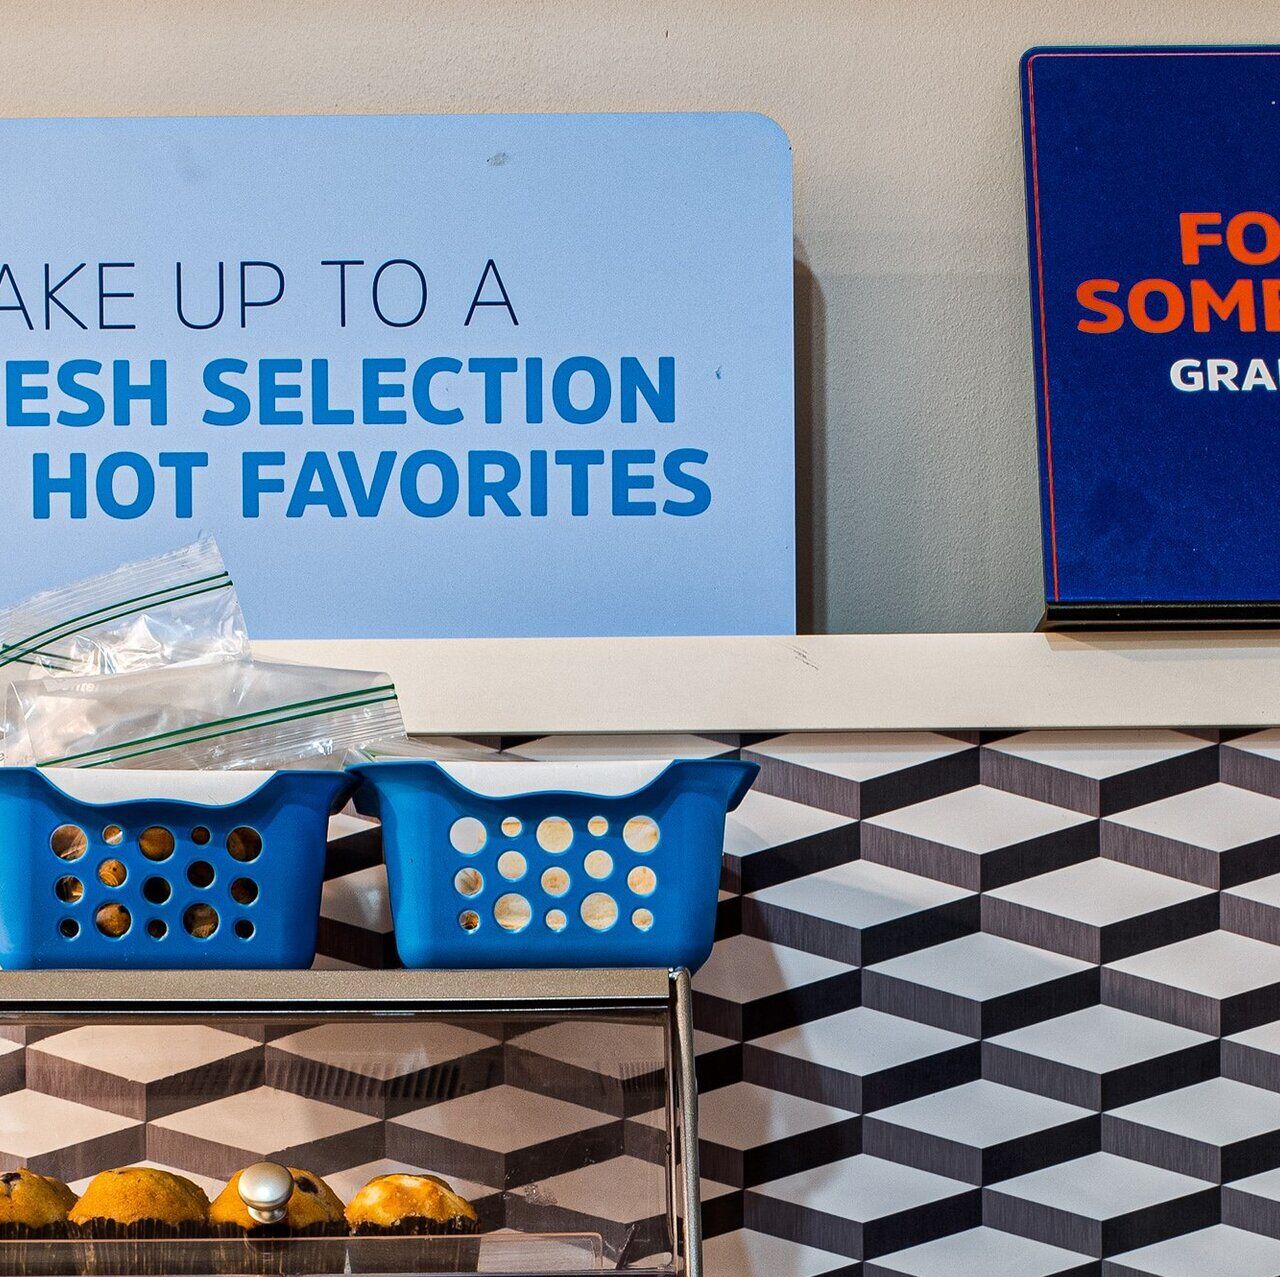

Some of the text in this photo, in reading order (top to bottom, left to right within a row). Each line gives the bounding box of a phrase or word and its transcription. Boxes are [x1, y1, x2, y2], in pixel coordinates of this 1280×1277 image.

[175, 261, 286, 330] UP
[320, 259, 429, 328] TO
[464, 258, 520, 327] A
[202, 355, 676, 426] SELECTION
[31, 451, 209, 521] HOT
[240, 447, 712, 519] FAVORITES
